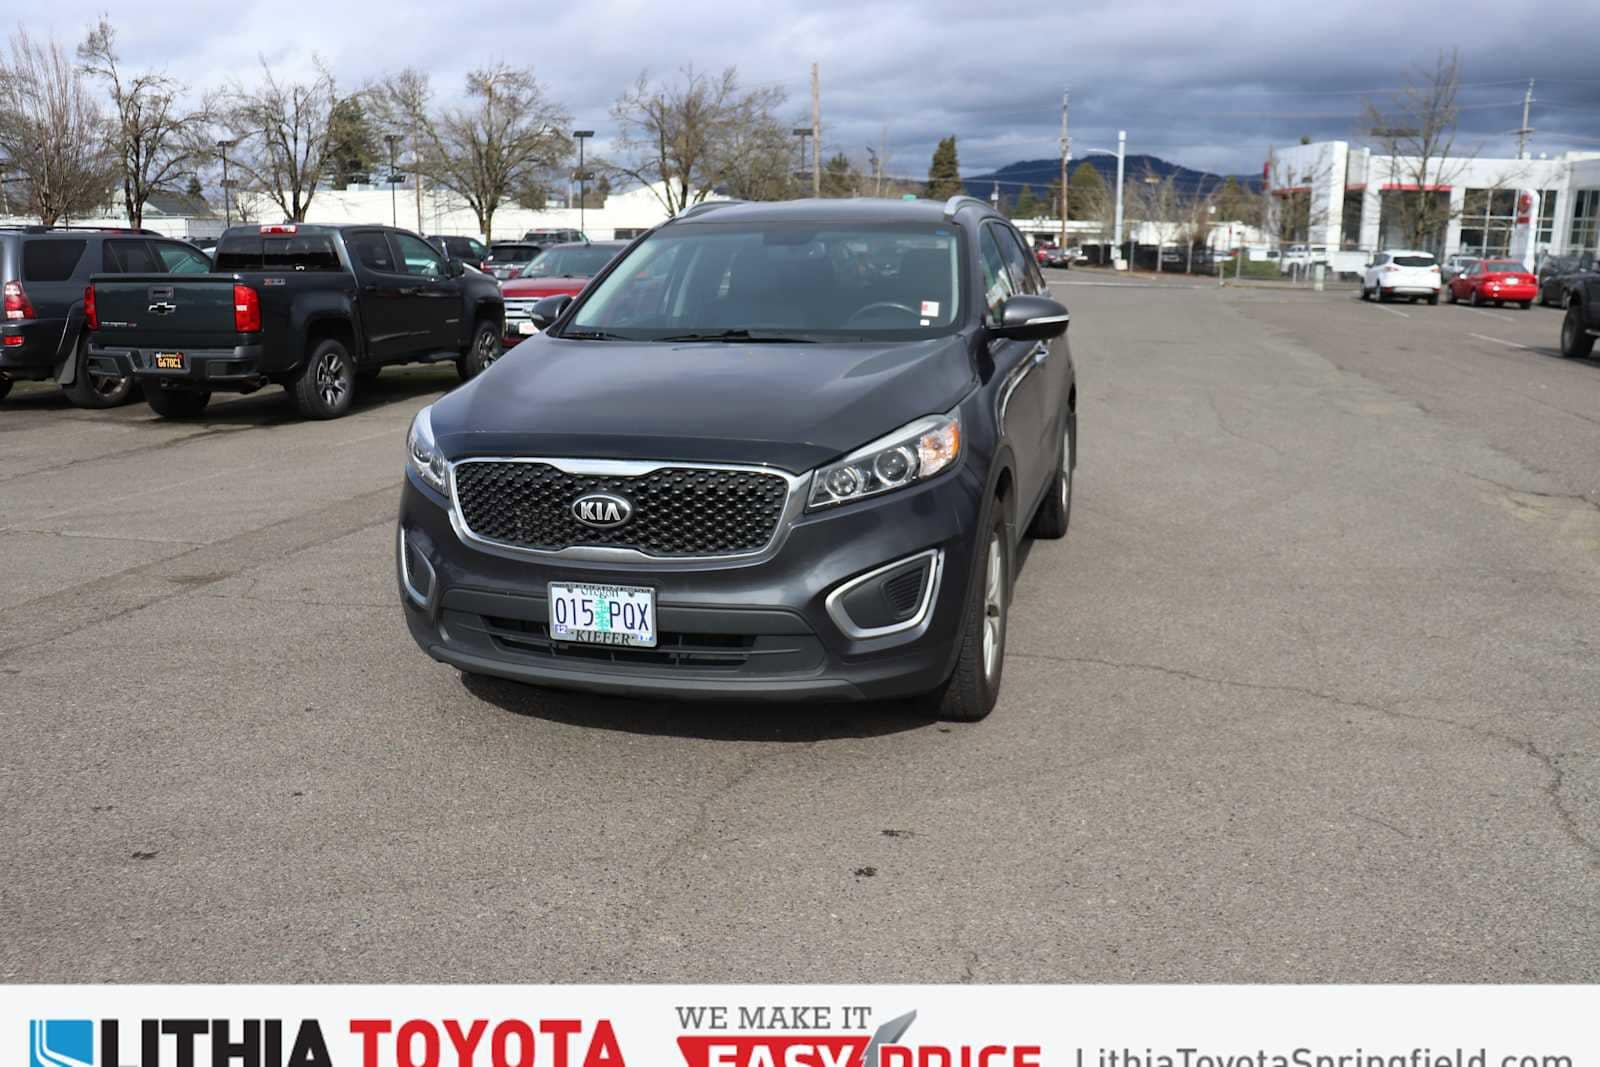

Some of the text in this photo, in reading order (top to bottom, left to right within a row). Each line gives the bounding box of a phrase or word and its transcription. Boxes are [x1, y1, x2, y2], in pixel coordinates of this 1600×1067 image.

[580, 502, 621, 521] KIA
[555, 597, 649, 631] 015 PQX
[576, 630, 631, 645] KIEFER
